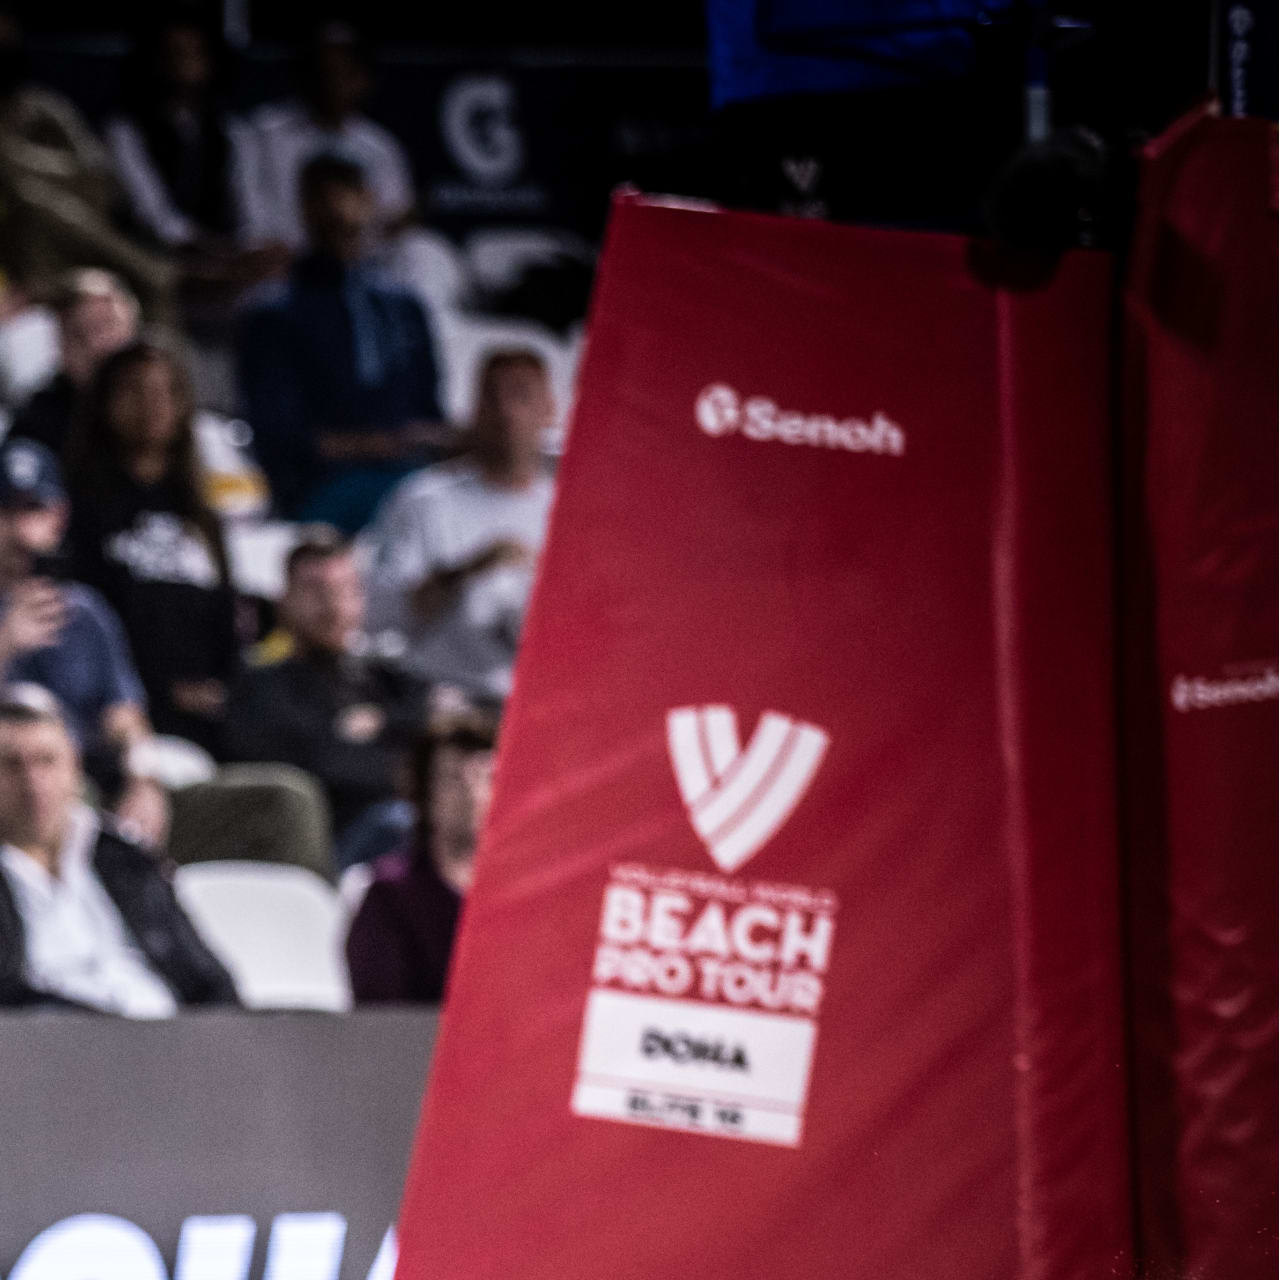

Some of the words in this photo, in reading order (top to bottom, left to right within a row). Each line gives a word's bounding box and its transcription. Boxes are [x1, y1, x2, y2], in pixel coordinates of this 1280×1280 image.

[743, 396, 905, 457] Senoh
[602, 886, 836, 972] BEACH
[592, 943, 694, 997] PRO
[699, 957, 825, 1018] TOUR
